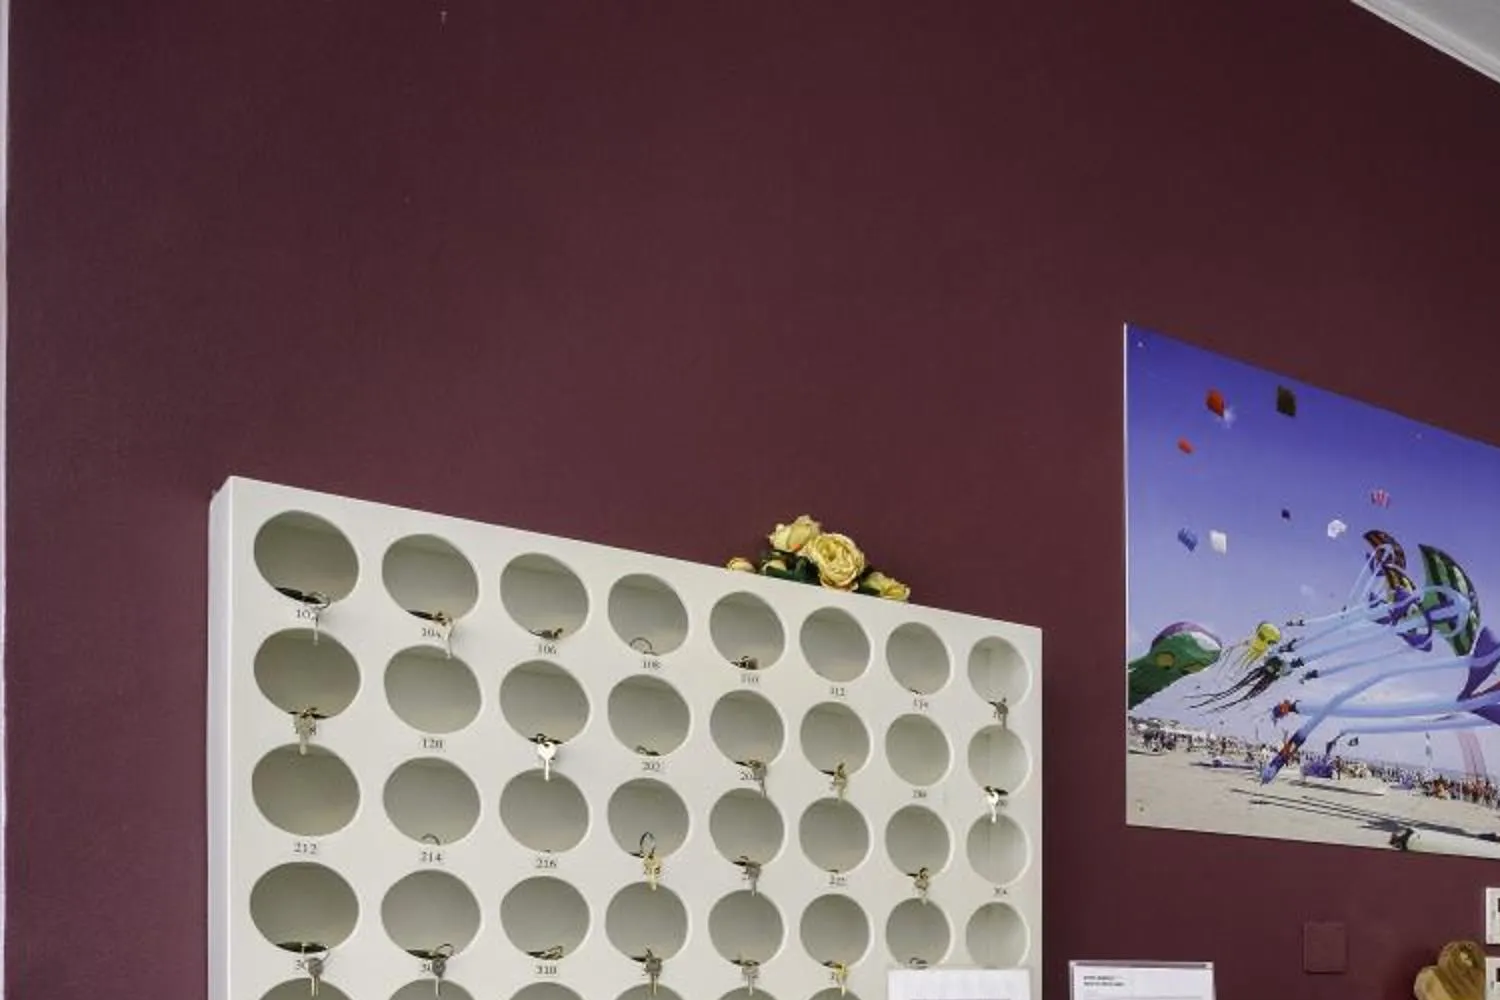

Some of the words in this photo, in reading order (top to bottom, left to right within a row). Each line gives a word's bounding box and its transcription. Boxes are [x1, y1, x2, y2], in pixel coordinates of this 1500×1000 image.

[539, 644, 557, 655] 106
[423, 738, 443, 749] 120
[294, 842, 317, 855] 212
[421, 851, 442, 864] 214
[537, 858, 557, 869] 216
